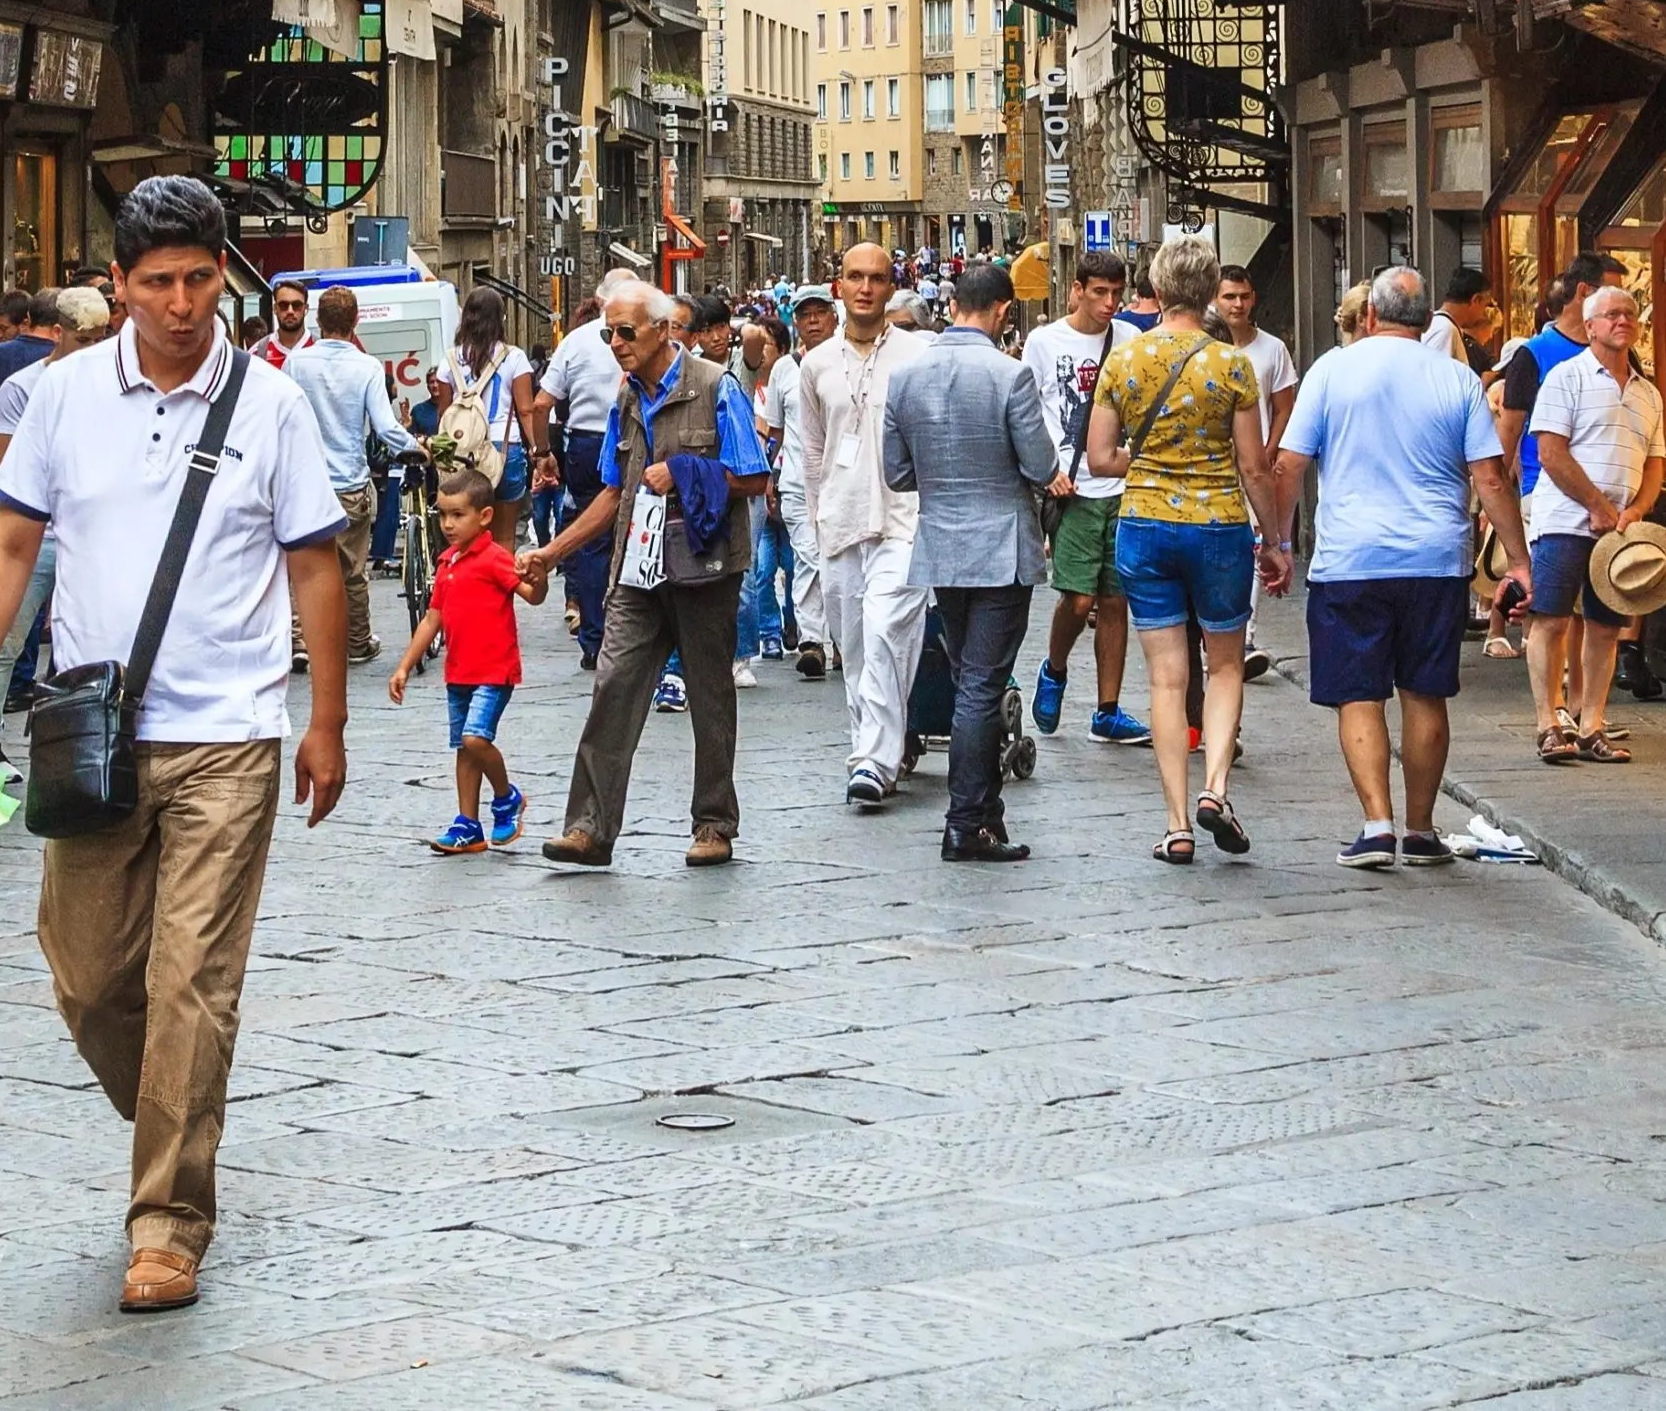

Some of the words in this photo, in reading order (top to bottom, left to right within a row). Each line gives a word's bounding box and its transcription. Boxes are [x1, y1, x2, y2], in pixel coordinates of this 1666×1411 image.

[544, 56, 570, 250] PICCINI
[1043, 67, 1071, 209] GLOVES
[540, 256, 575, 276] UGO
[184, 444, 243, 462] CHION
